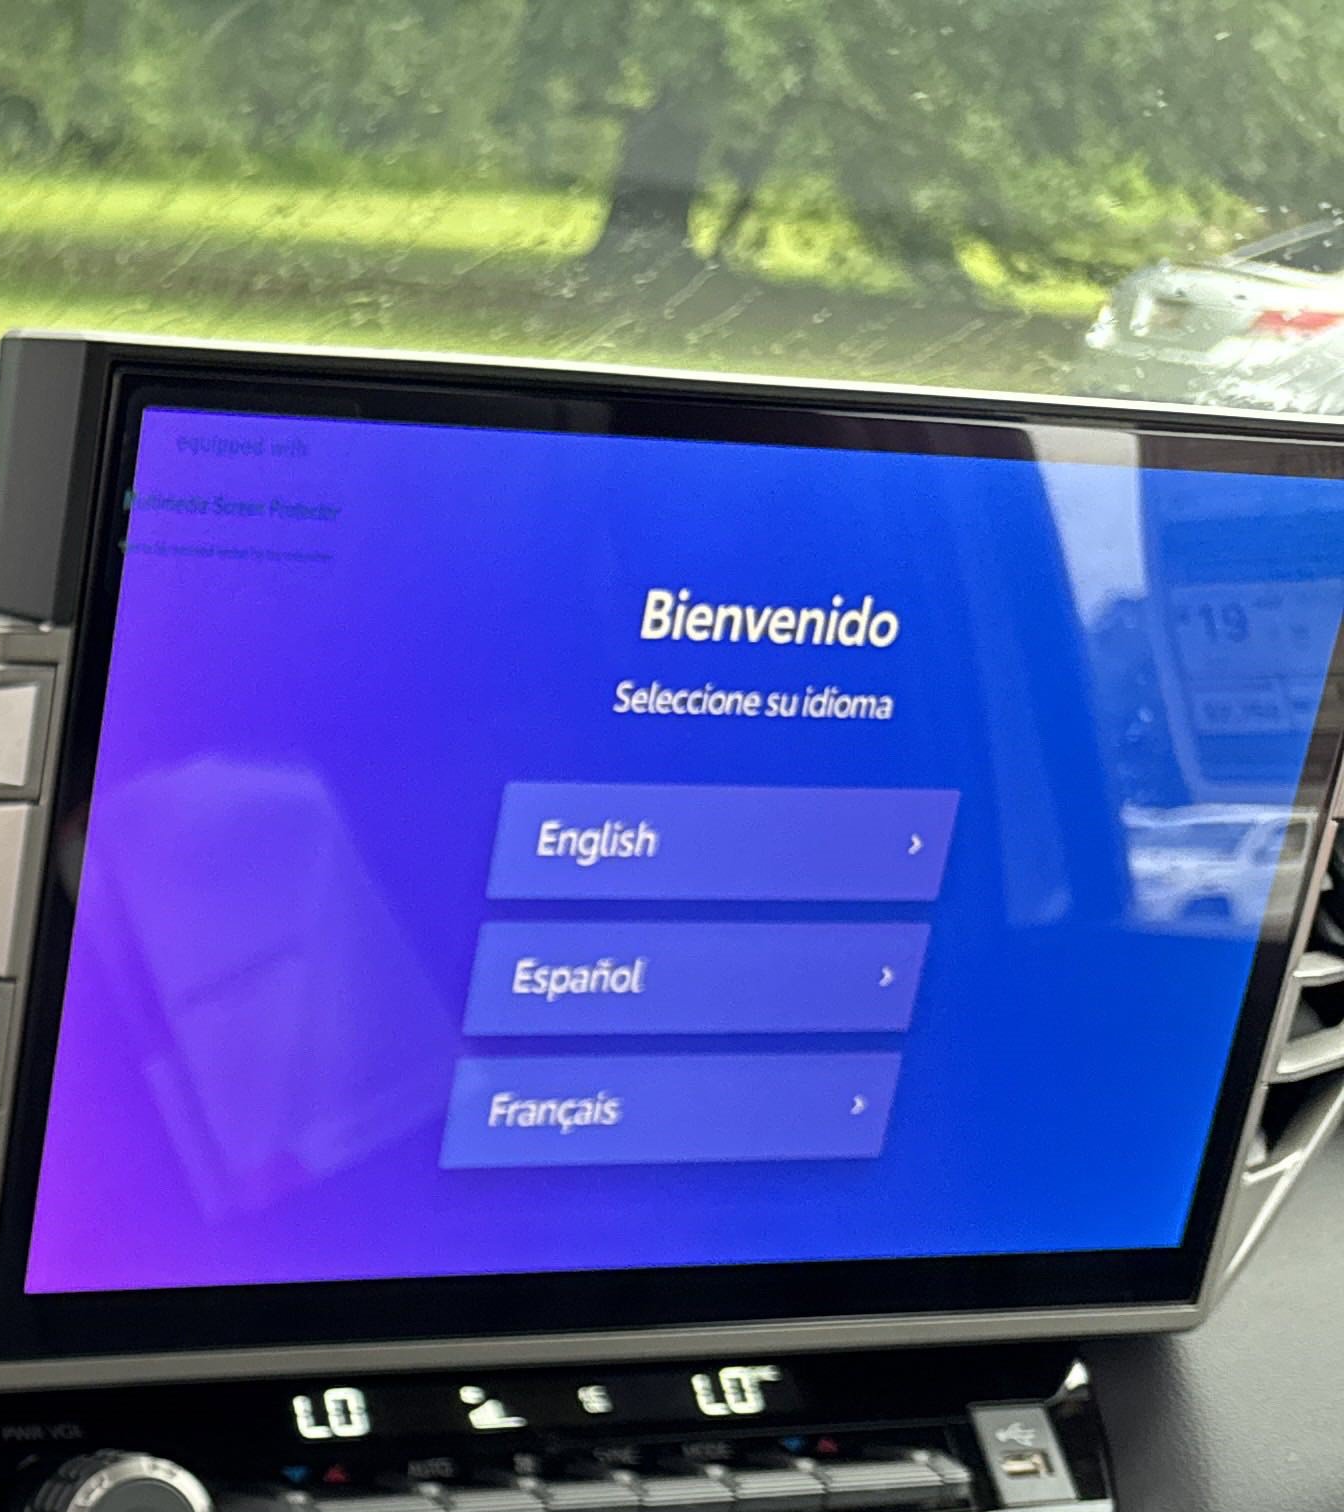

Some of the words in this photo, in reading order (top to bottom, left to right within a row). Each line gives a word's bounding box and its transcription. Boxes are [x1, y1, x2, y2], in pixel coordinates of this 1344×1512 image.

[641, 588, 900, 648] Bienvenido
[613, 681, 761, 718] Seleccione
[767, 692, 798, 718] su
[802, 685, 895, 720] idioma
[536, 820, 660, 866] English
[511, 957, 649, 1003] Español
[487, 1091, 622, 1135] Français
